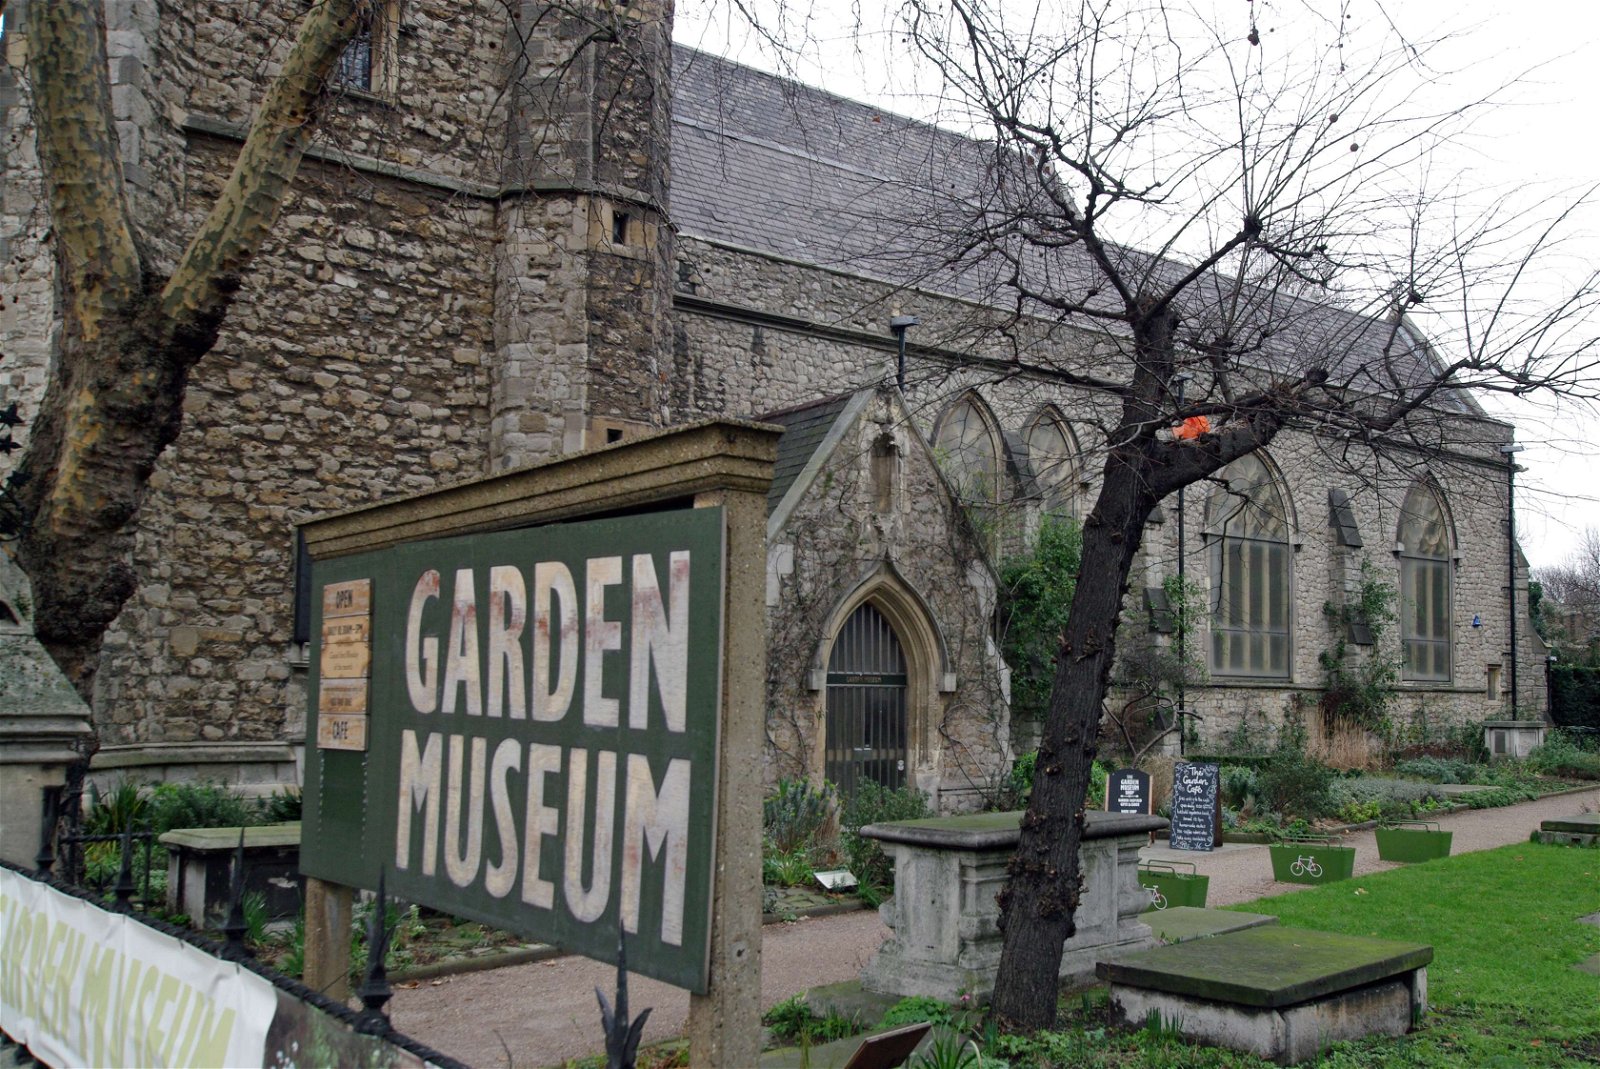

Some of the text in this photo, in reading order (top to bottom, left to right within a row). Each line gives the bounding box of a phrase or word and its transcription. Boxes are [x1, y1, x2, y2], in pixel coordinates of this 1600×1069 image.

[335, 589, 354, 609] OPEN
[405, 550, 690, 733] GARDEN
[332, 720, 349, 740] CAFE
[1182, 775, 1209, 786] Garden
[1189, 766, 1204, 776] The
[396, 729, 691, 947] MUSEUM
[0, 893, 237, 1069] ARDEN MUSEUM
